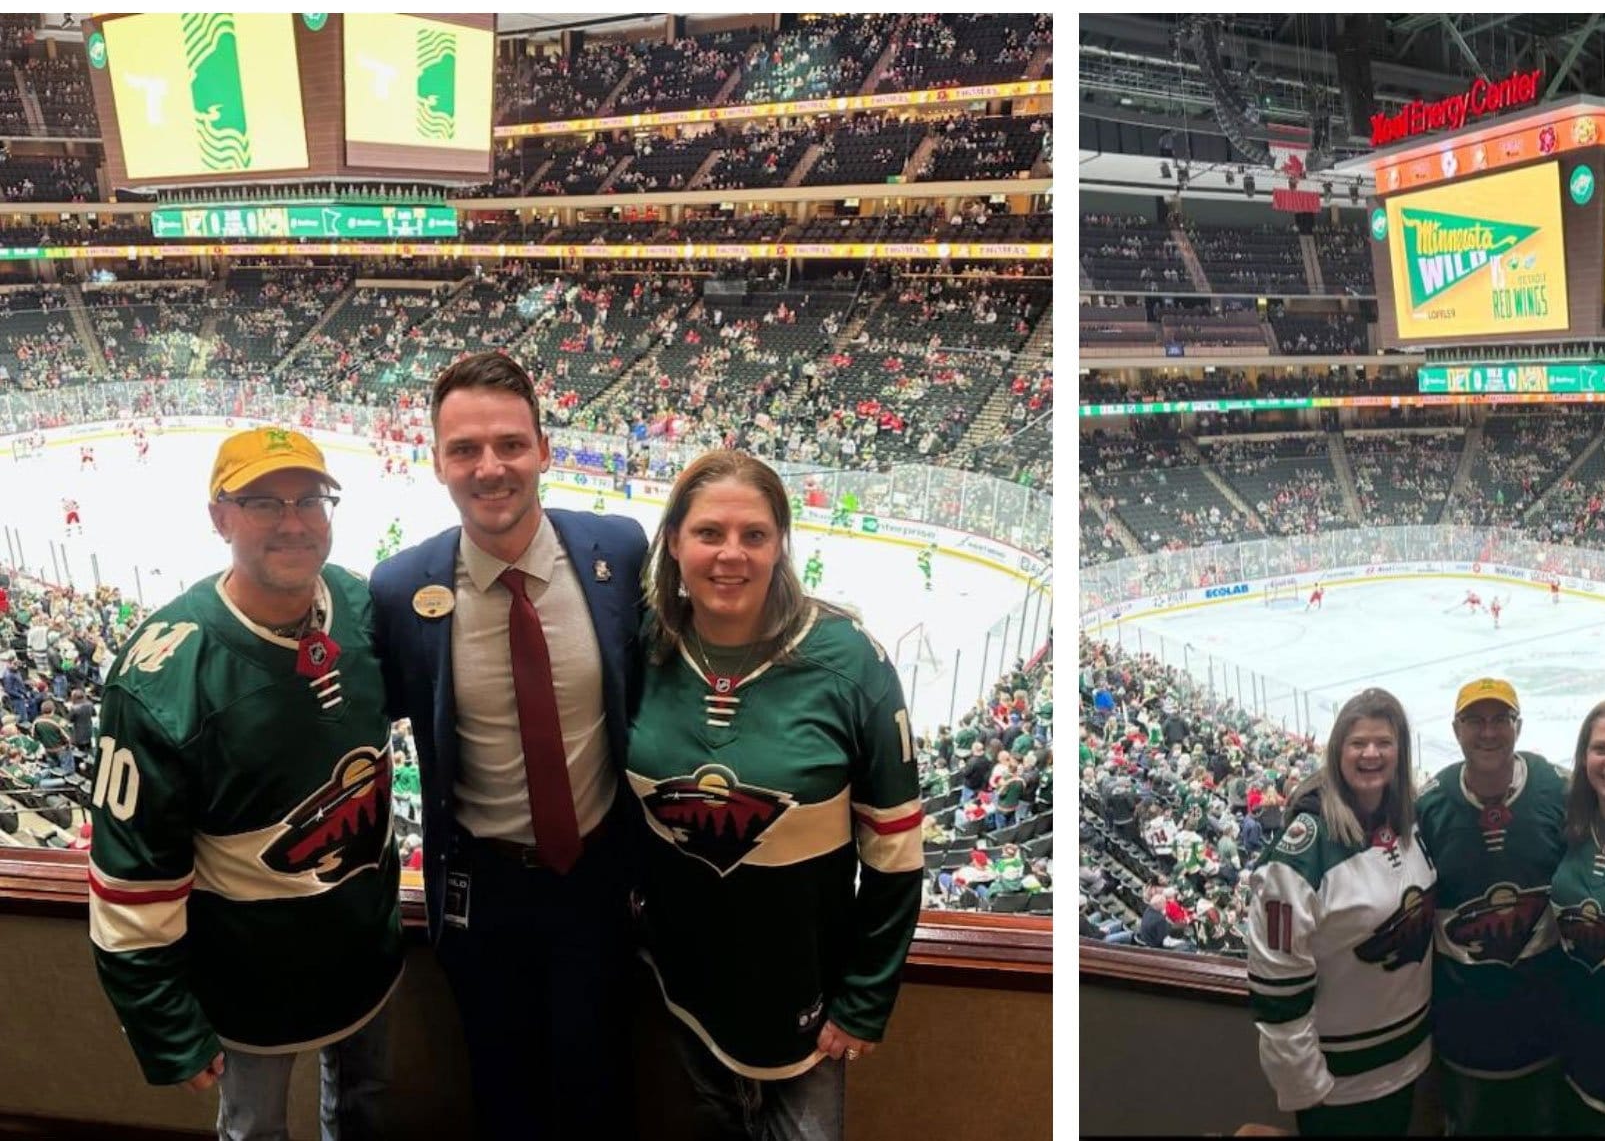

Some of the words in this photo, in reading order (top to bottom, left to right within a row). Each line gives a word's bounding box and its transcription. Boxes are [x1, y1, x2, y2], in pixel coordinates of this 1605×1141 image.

[1410, 92, 1470, 134] Energy
[1471, 69, 1543, 117] Center
[1415, 219, 1497, 256] Minnesota
[1492, 289, 1512, 321] RED
[1513, 285, 1549, 318] WINGS
[1204, 583, 1250, 599] ECOLAB
[893, 707, 915, 765] 1
[91, 735, 140, 822] 10
[1265, 899, 1294, 955] 11
